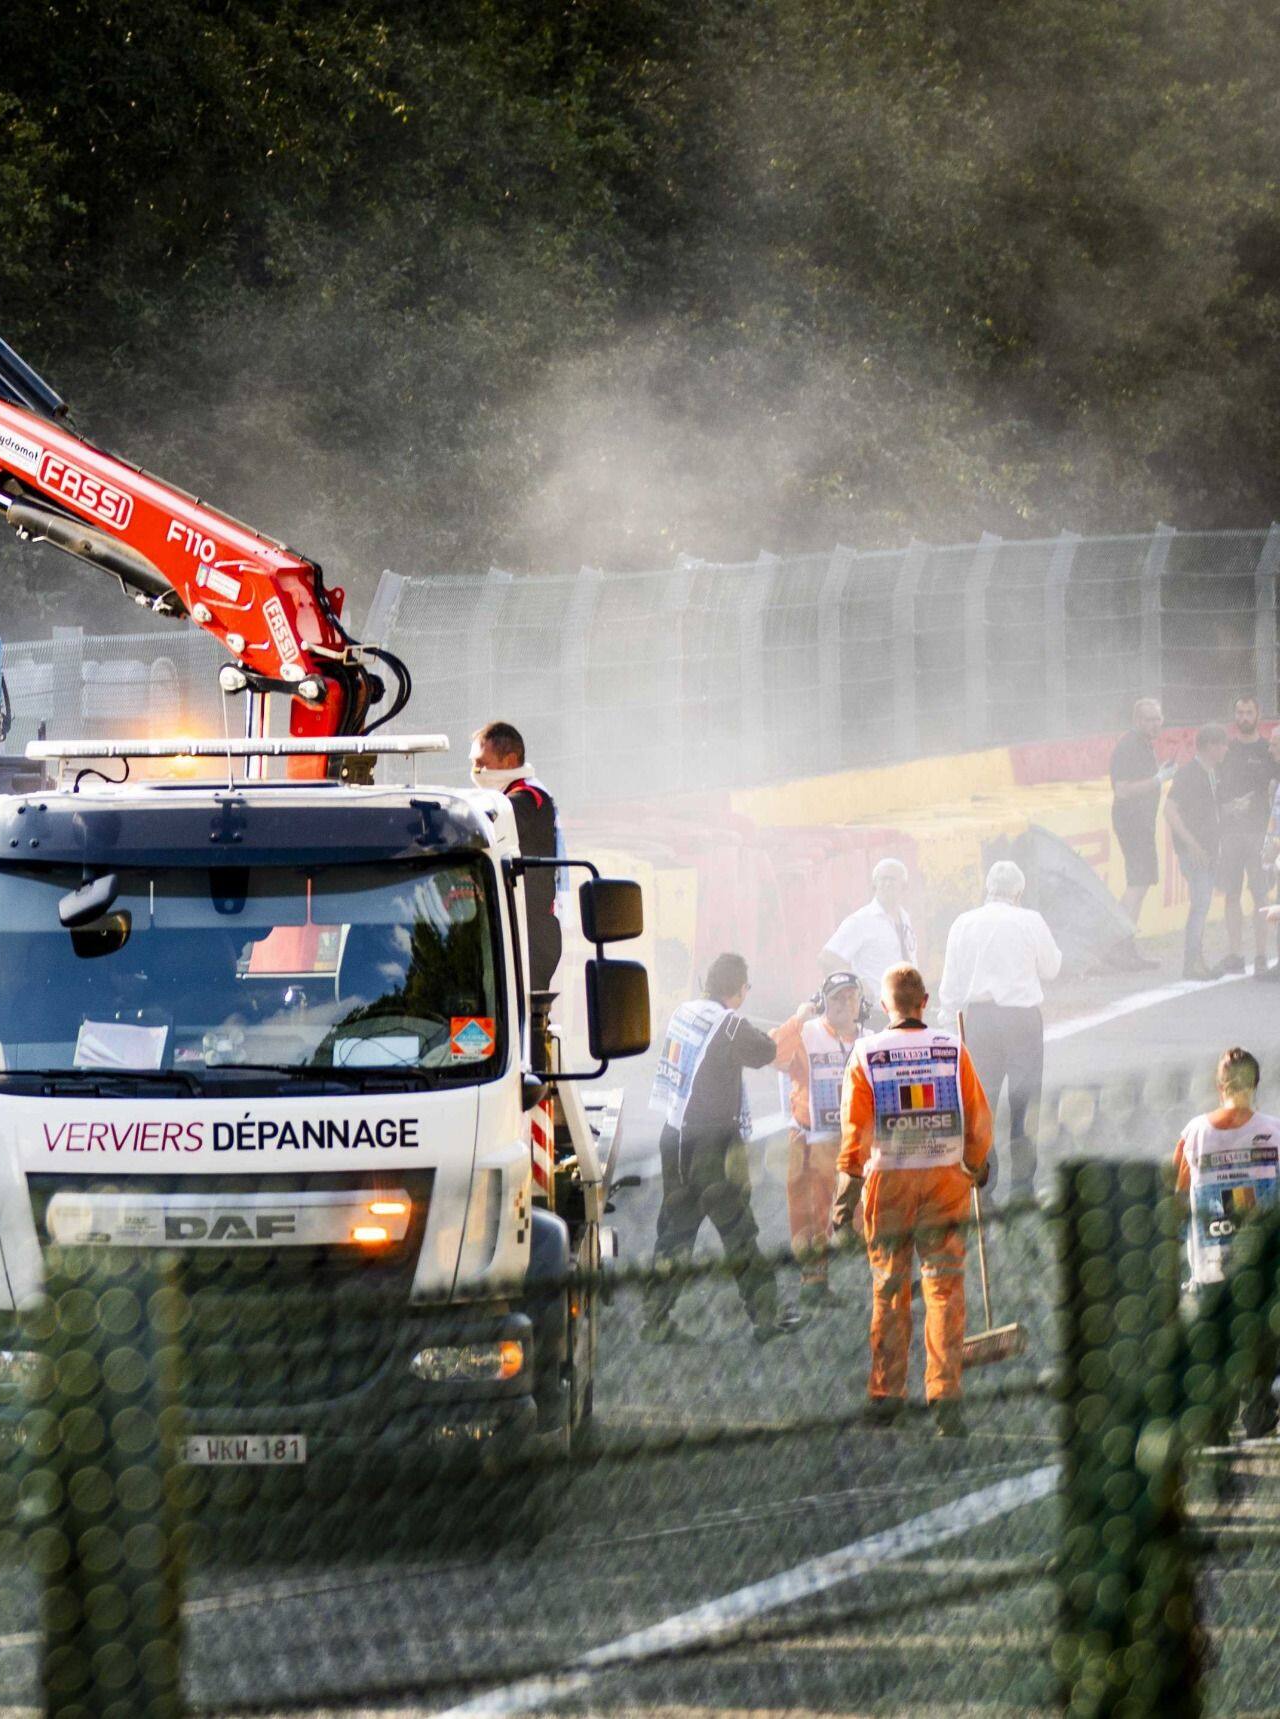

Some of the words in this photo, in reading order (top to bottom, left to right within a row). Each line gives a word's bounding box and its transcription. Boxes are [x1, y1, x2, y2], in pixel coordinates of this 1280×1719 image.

[44, 458, 126, 523] FASSI
[167, 519, 216, 563] F110
[265, 600, 297, 661] FASSI
[42, 1122, 205, 1152] VERVIERS
[213, 1112, 419, 1151] DÉPANNAGE
[886, 1114, 952, 1130] COURSE
[164, 1215, 296, 1240] DAF
